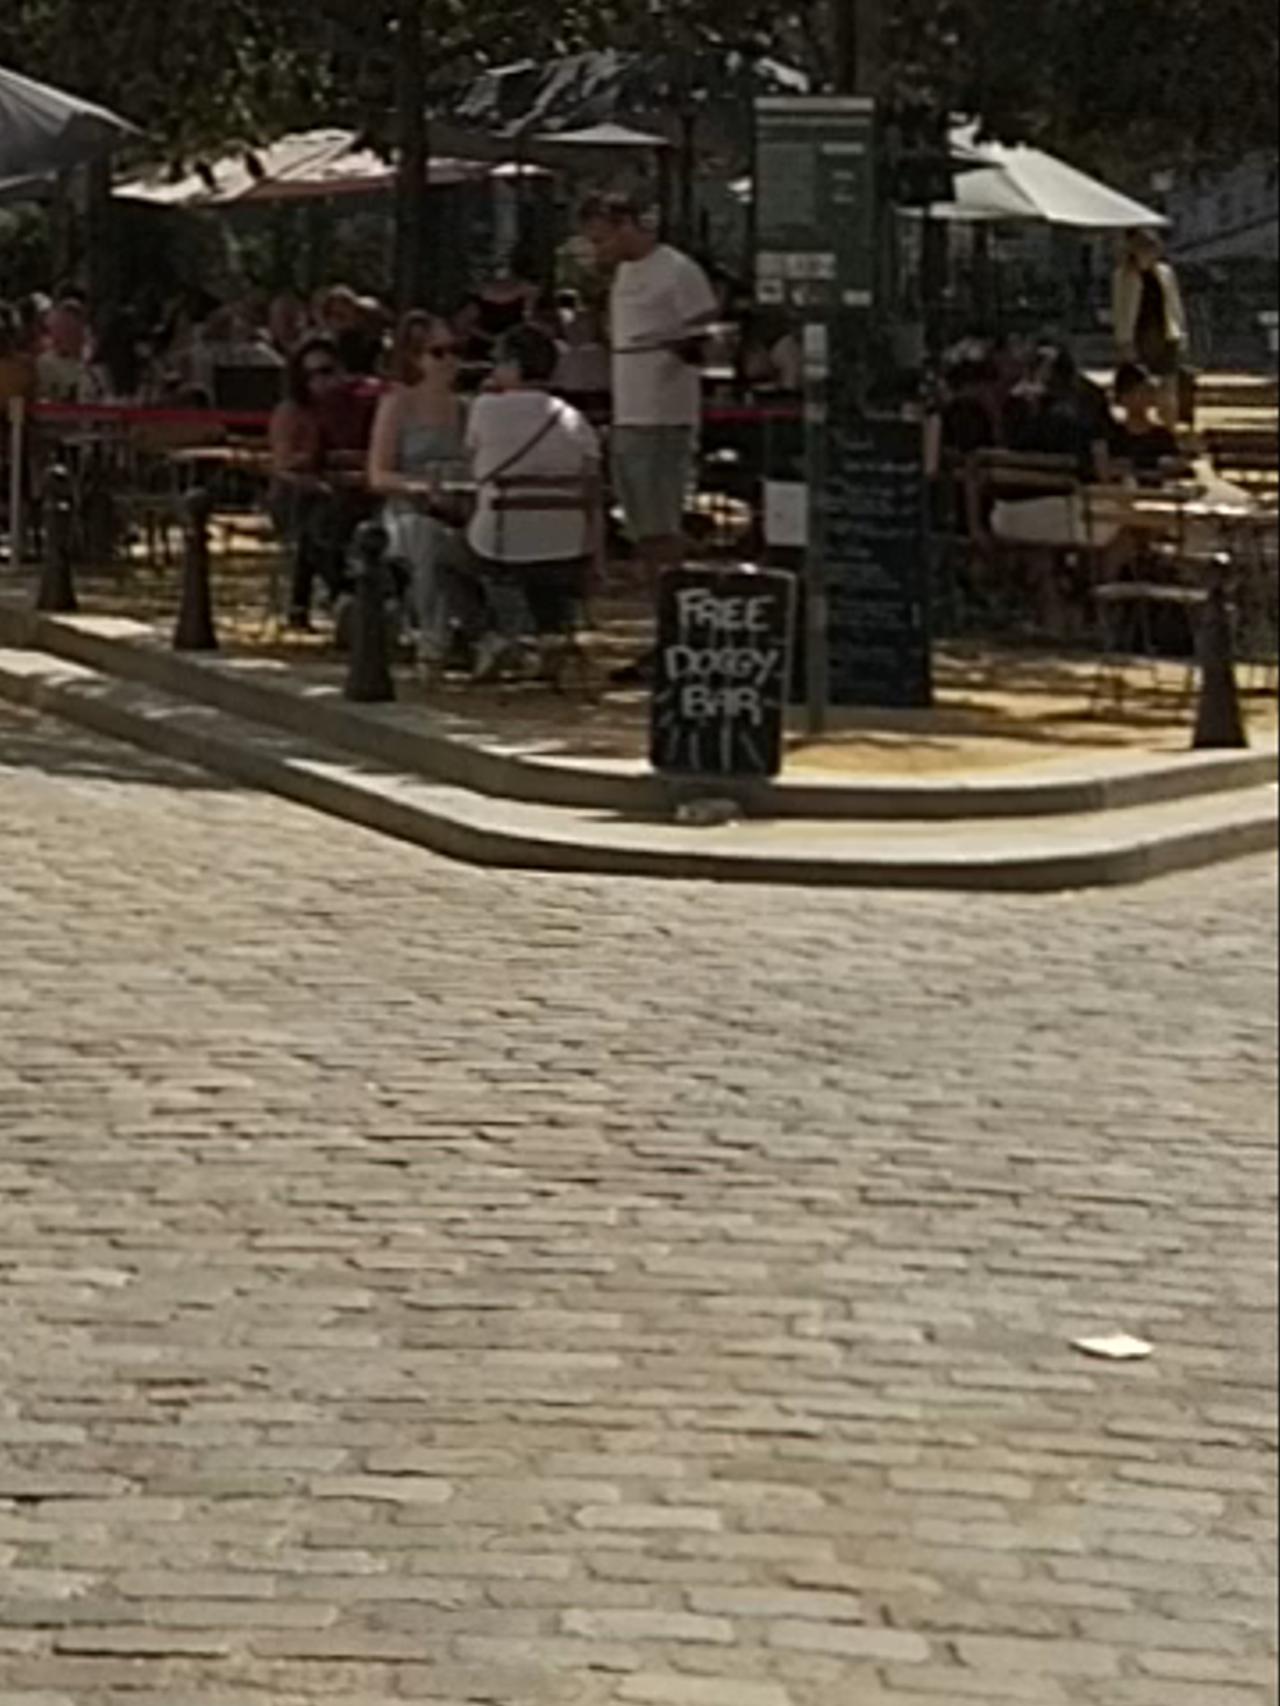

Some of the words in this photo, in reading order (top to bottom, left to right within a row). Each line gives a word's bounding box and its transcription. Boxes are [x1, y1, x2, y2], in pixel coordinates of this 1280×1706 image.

[675, 587, 776, 632] FREE
[664, 644, 780, 686] DOGGY
[681, 686, 762, 726] BAR
